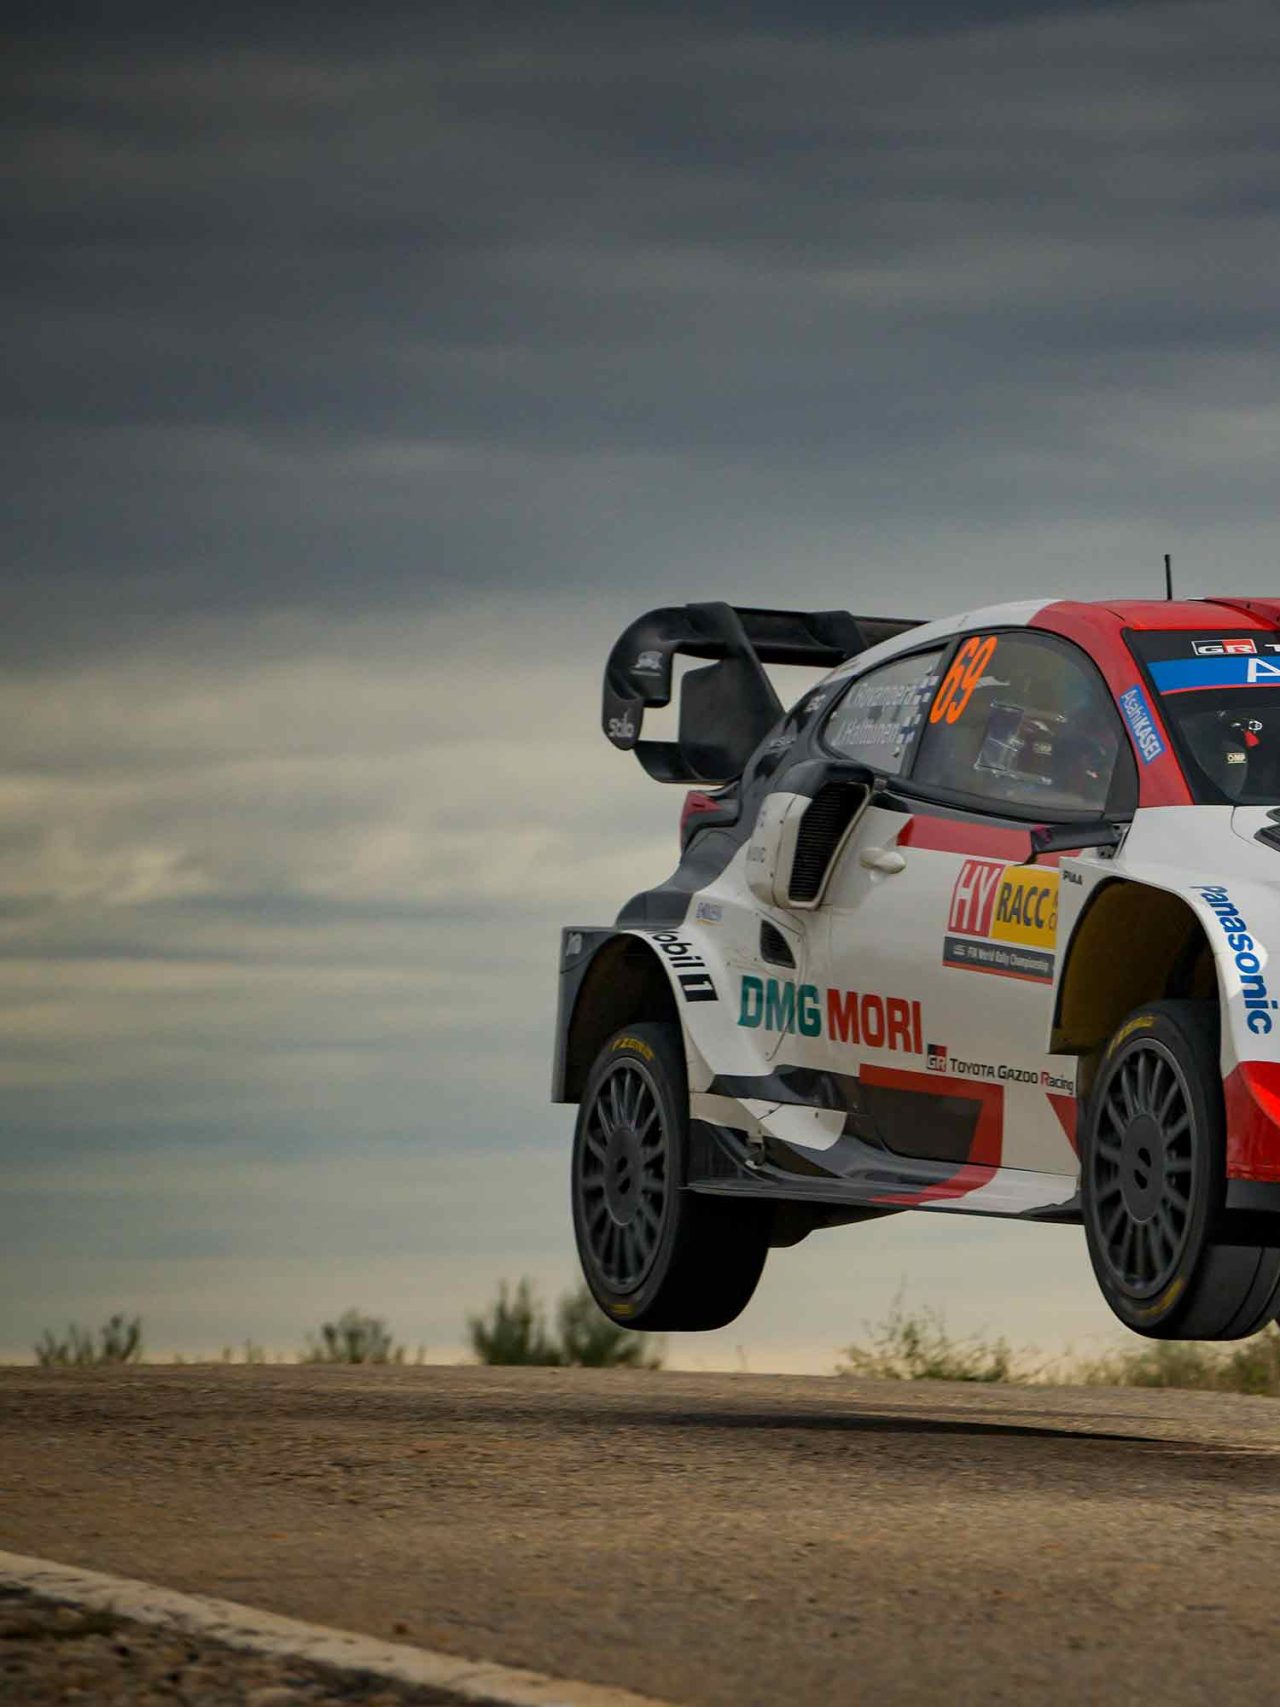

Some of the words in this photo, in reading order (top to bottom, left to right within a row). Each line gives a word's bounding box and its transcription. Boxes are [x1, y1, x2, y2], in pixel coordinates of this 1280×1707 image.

[929, 636, 998, 724] 69
[1197, 643, 1254, 654] GR
[1121, 688, 1162, 761] AsahiKASEI
[950, 862, 1002, 932] HY
[996, 881, 1050, 929] RACC
[647, 930, 705, 968] obil
[1189, 885, 1278, 1034] Panasonic
[737, 975, 822, 1037] DMG
[826, 988, 924, 1054] MORI
[928, 1055, 946, 1072] GR
[950, 1058, 996, 1078] TOYOTA
[997, 1065, 1038, 1084] GAZOO
[1040, 1071, 1075, 1094] Racing
